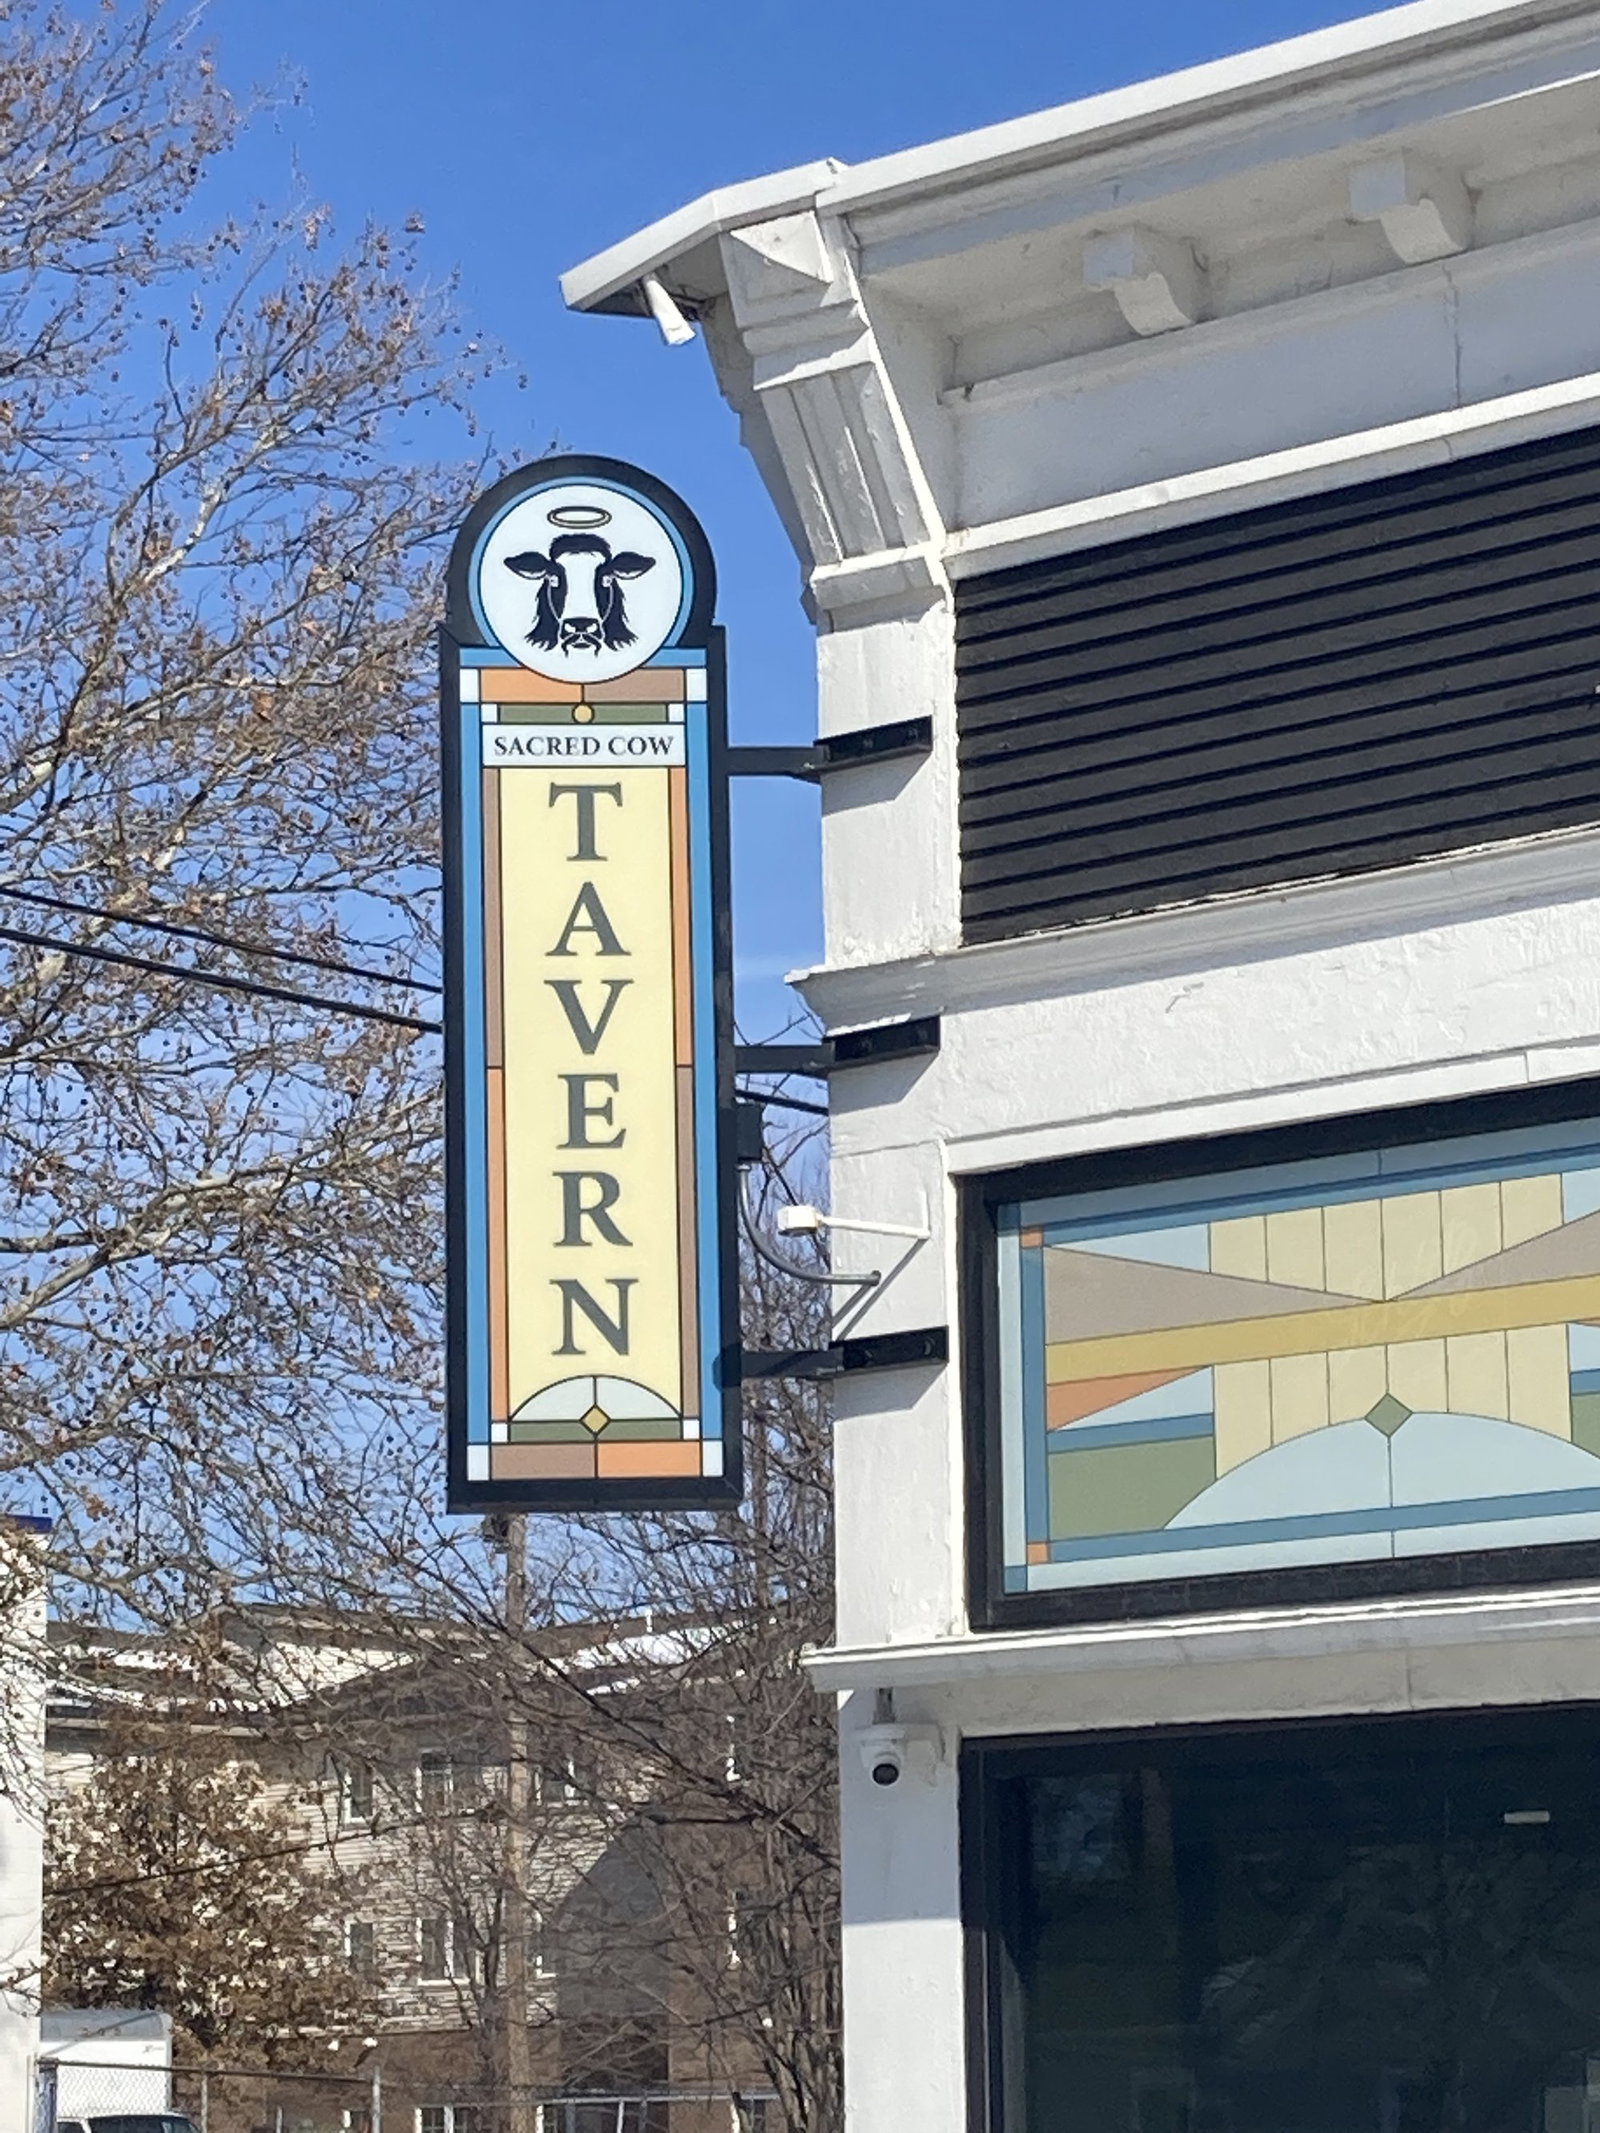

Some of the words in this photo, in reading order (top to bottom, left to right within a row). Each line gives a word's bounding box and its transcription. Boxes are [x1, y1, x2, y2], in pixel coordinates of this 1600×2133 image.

[494, 735, 600, 756] SACRED
[607, 735, 674, 756] COW
[543, 781, 639, 1356] TAVERN
